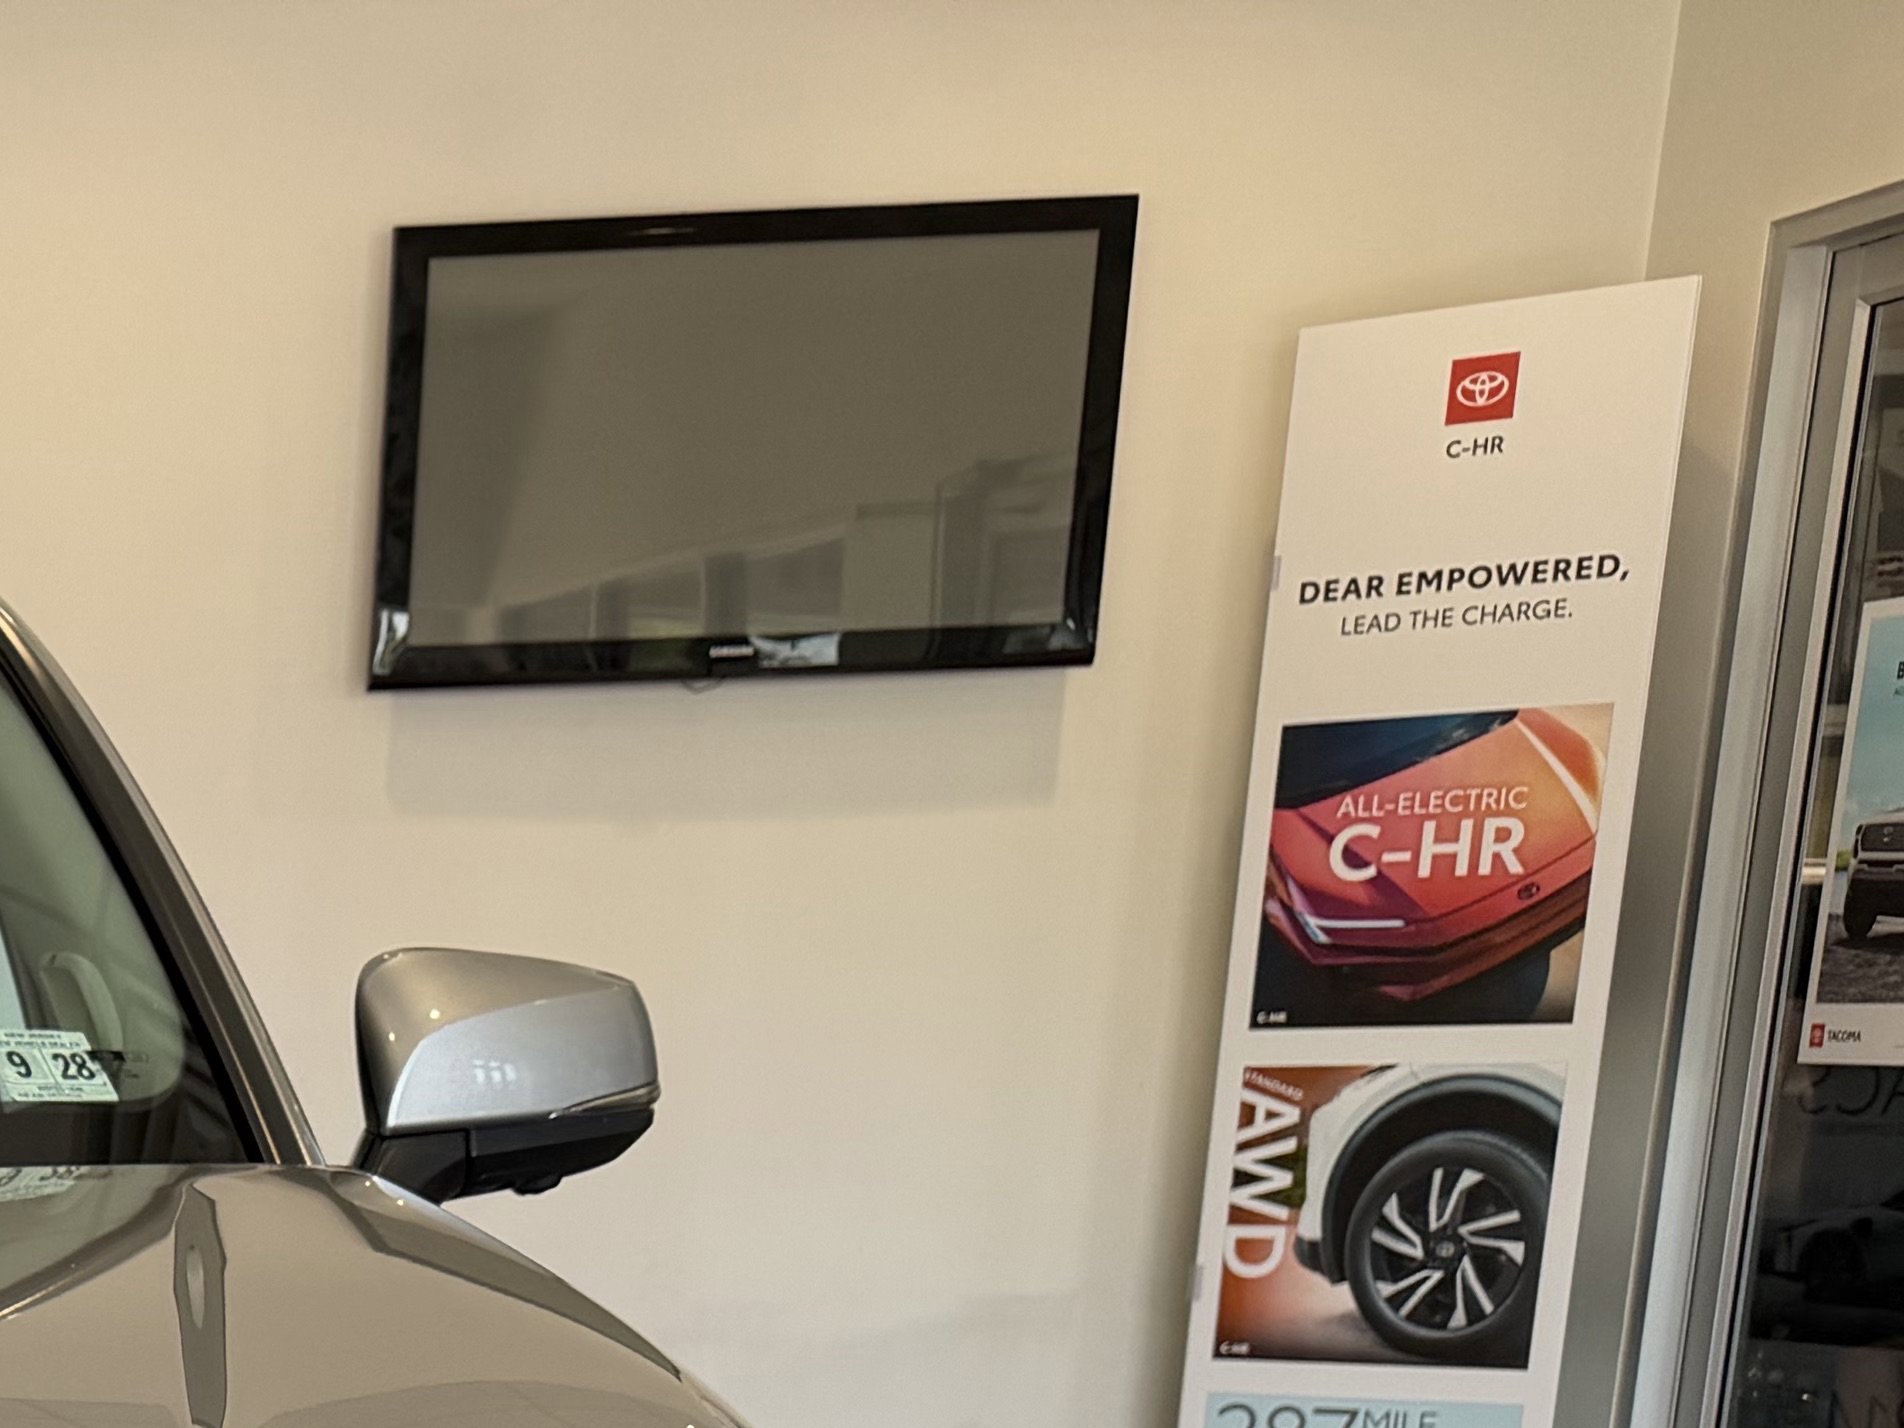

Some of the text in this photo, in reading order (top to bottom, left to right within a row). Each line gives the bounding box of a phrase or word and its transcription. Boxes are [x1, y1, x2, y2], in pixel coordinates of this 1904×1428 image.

[1446, 435, 1504, 459] C-HR
[1298, 554, 1631, 605] DEAR EMPOWERED,
[1340, 597, 1573, 637] LEAD THE CHARGE.
[1335, 786, 1529, 819] ALL-ELECTRIC
[1328, 816, 1526, 882] C-HR
[1827, 1030, 1862, 1043] TACOMA
[5, 1050, 33, 1079] 9
[52, 1052, 96, 1081] 28
[1222, 1086, 1302, 1279] AWD
